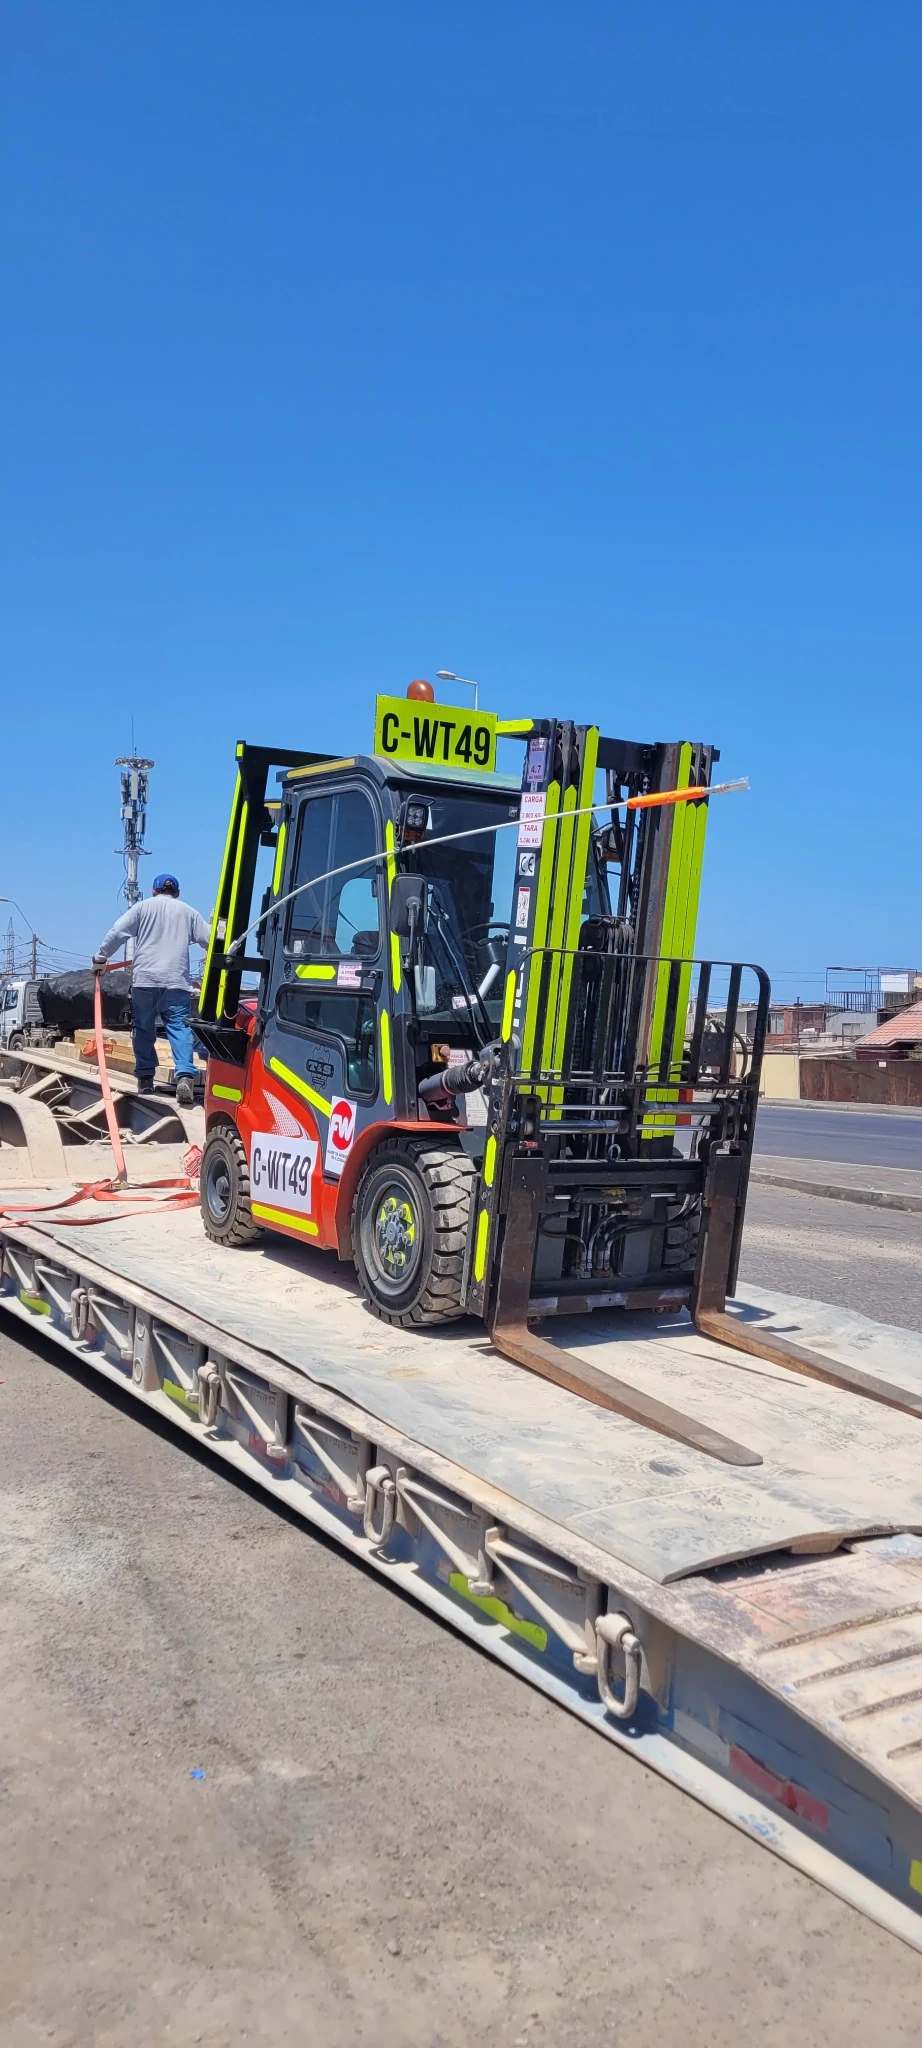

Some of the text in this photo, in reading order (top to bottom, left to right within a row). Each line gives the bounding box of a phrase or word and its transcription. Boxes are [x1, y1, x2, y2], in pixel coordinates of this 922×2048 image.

[381, 712, 491, 766] C-WT49
[530, 764, 542, 774] 4.7
[524, 795, 543, 803] CARGA
[523, 824, 538, 832] TARA
[308, 1060, 332, 1077] T&S
[330, 1113, 354, 1142] FW
[253, 1147, 312, 1197] C-WT49
